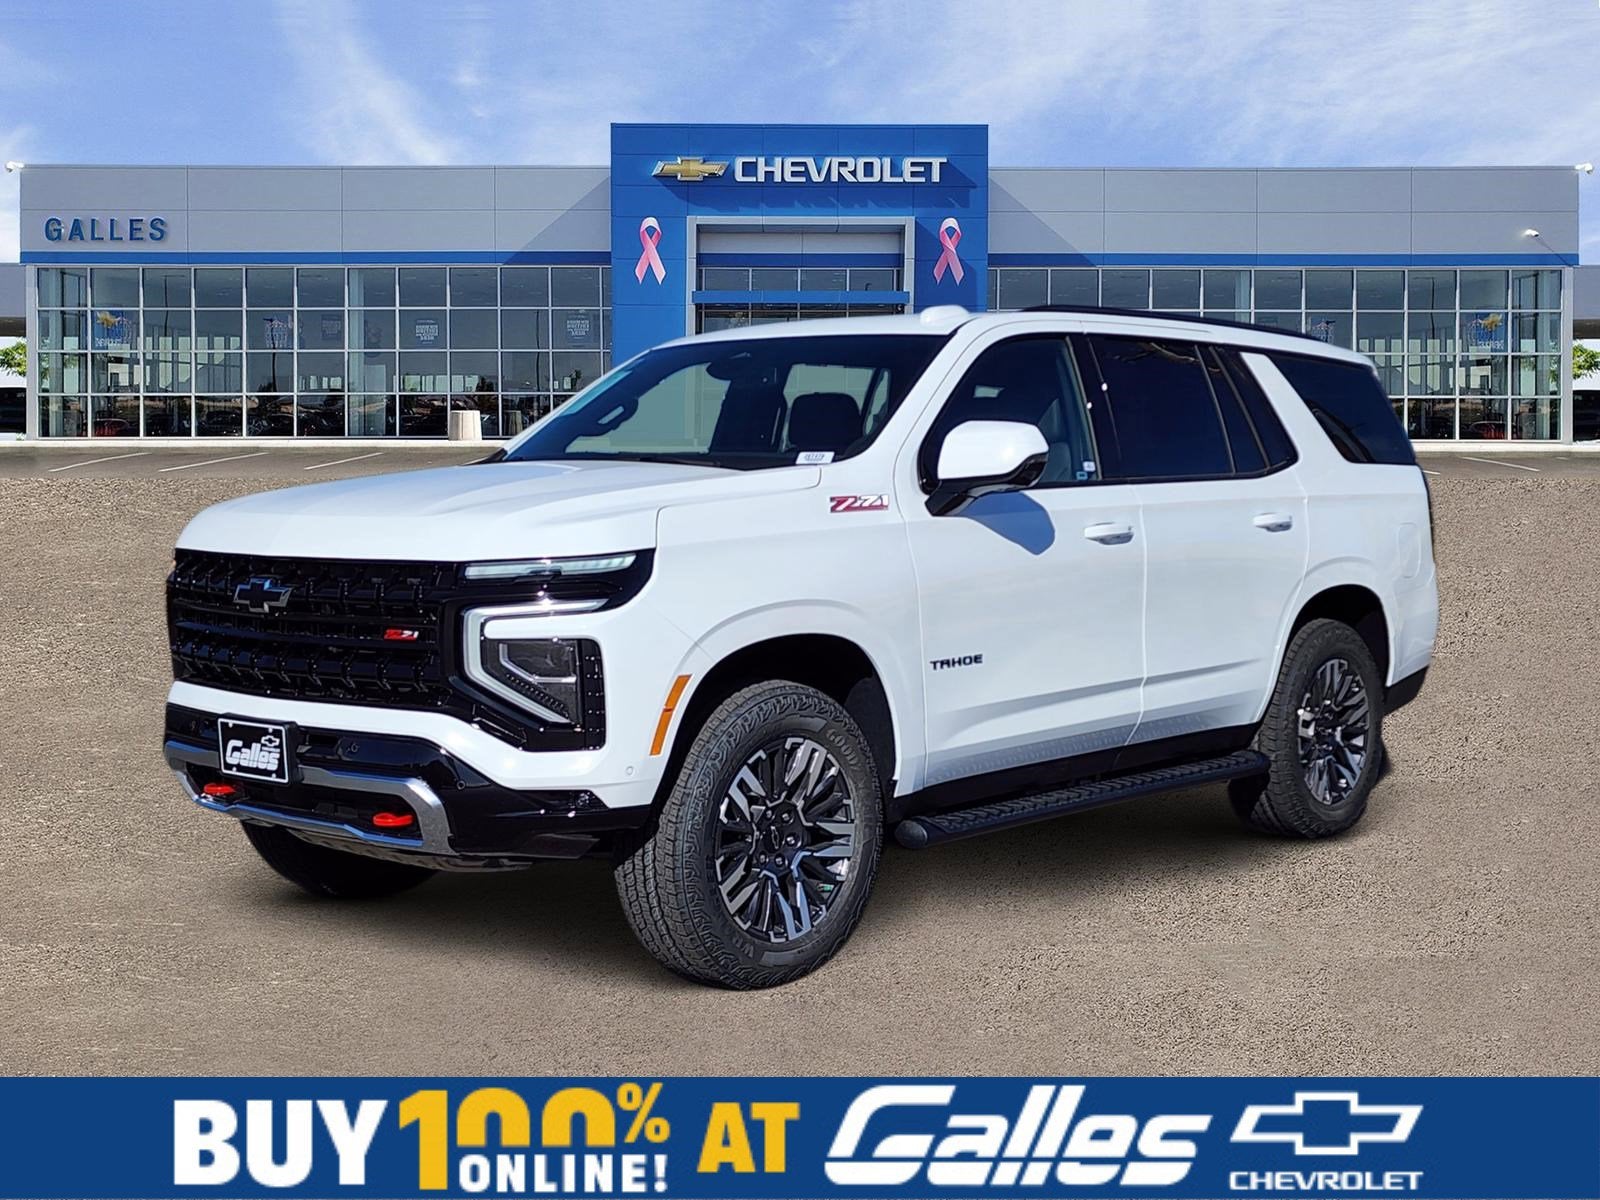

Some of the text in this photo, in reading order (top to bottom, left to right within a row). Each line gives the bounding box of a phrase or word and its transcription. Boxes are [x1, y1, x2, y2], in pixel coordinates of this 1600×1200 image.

[734, 157, 947, 183] CHEVROLET
[44, 215, 168, 242] GALLES
[829, 494, 889, 513] Z71
[383, 628, 419, 641] Z71
[930, 653, 983, 671] TAHOE
[225, 738, 281, 771] Galles
